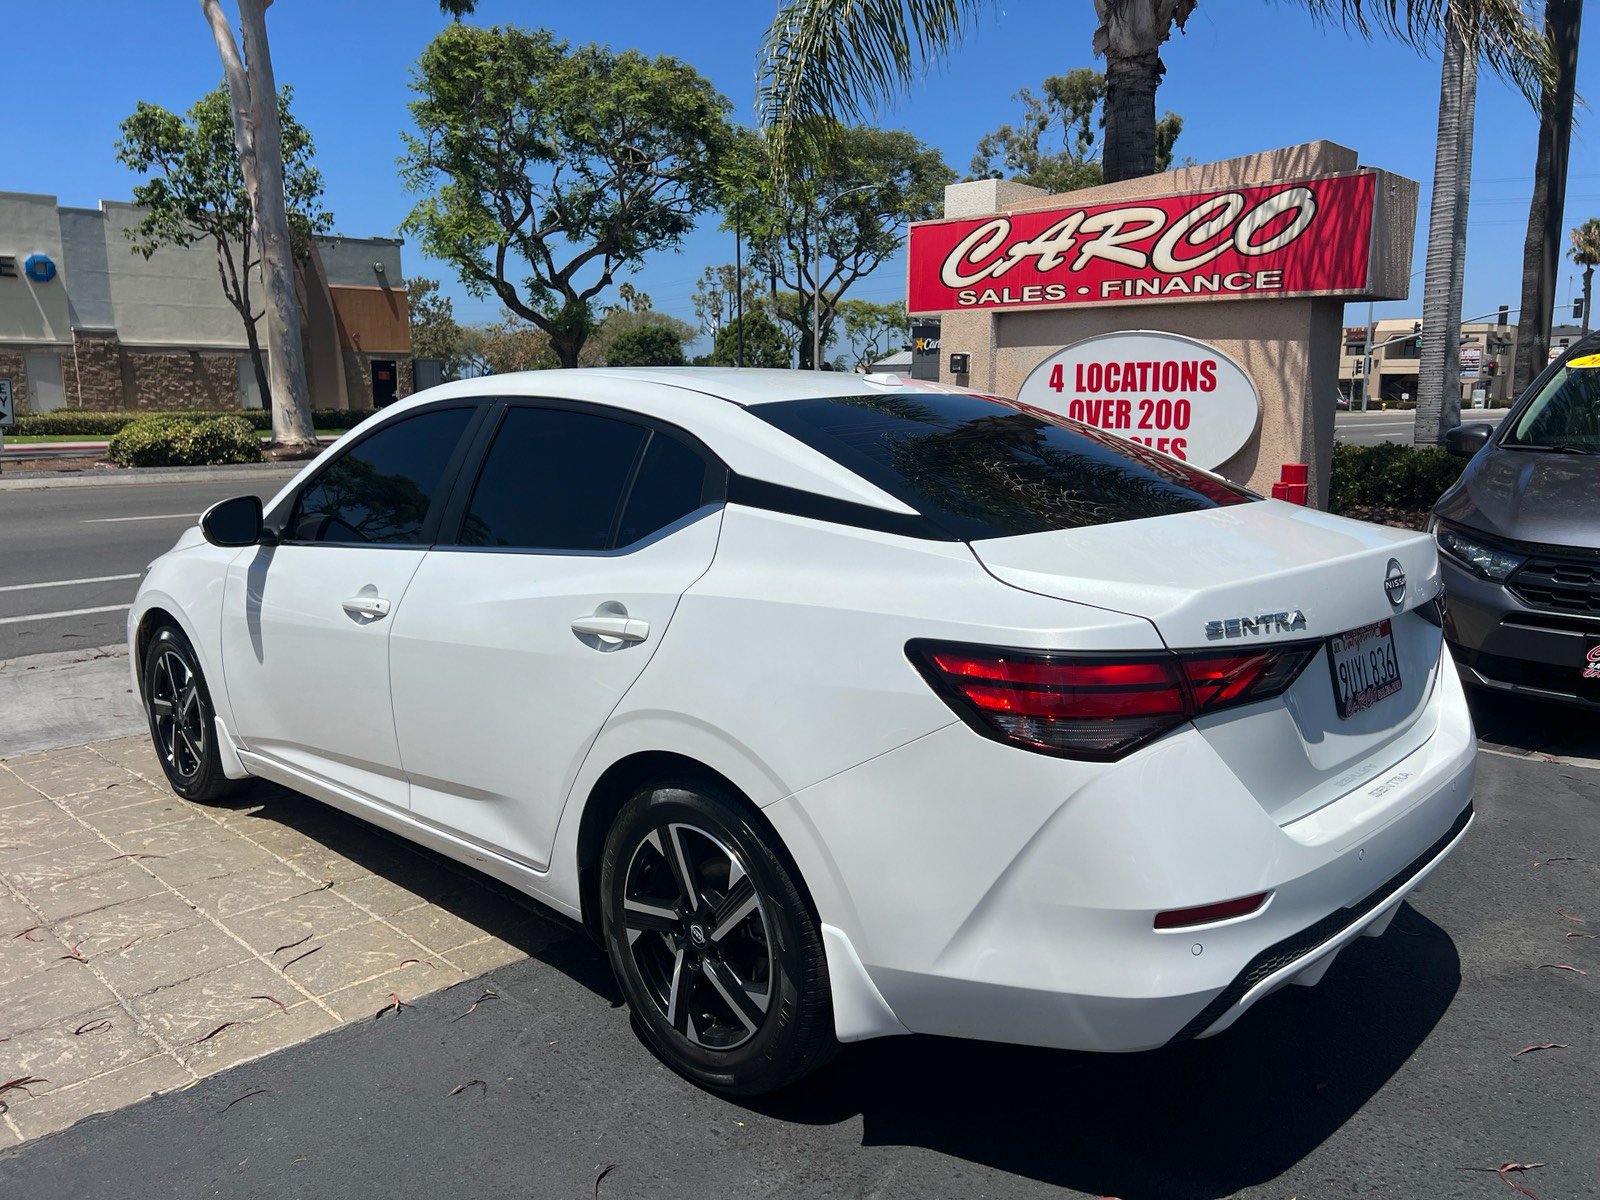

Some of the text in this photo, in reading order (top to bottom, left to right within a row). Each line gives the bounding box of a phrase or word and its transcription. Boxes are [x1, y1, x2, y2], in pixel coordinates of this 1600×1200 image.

[940, 186, 1319, 290] CARCO
[957, 269, 1285, 307] SALES FINANCE
[1049, 360, 1218, 393] 4 LOCATIONS
[1069, 399, 1192, 431] OVER 200
[1385, 577, 1407, 590] NISS
[1205, 610, 1307, 640] SENTRA
